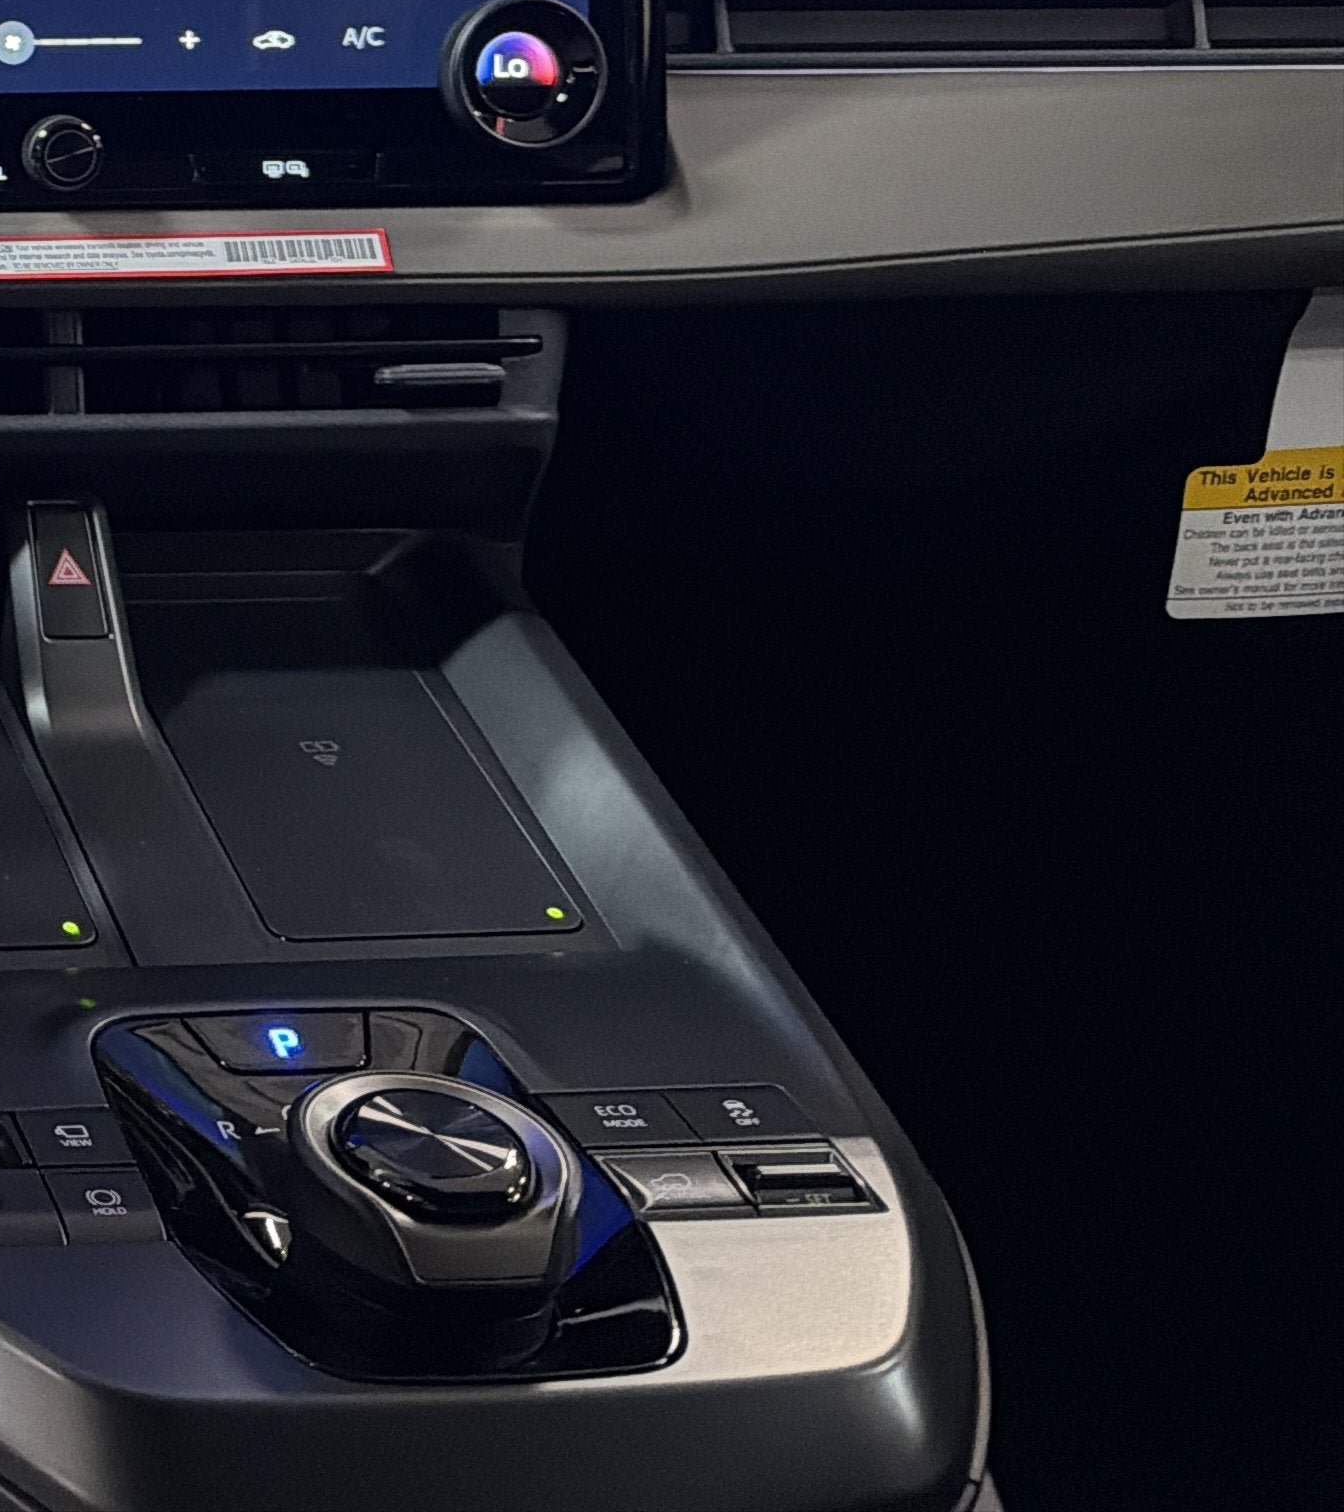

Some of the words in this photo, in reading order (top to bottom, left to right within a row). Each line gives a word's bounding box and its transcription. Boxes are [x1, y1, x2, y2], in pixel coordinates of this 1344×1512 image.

[342, 25, 386, 50] A/C
[493, 53, 529, 78] Lo
[1200, 470, 1237, 485] This
[1247, 467, 1311, 484] Vehicle
[1320, 464, 1335, 480] is
[1244, 484, 1335, 502] Advanced
[1223, 511, 1260, 525] Even
[1264, 511, 1293, 522] with
[268, 1028, 299, 1059] P
[594, 1105, 637, 1117] ECO
[216, 1120, 242, 1140] R
[603, 1119, 648, 1128] MODE
[735, 1117, 761, 1127] OFF
[60, 1139, 93, 1147] VIEW
[92, 1207, 128, 1216] HOLD
